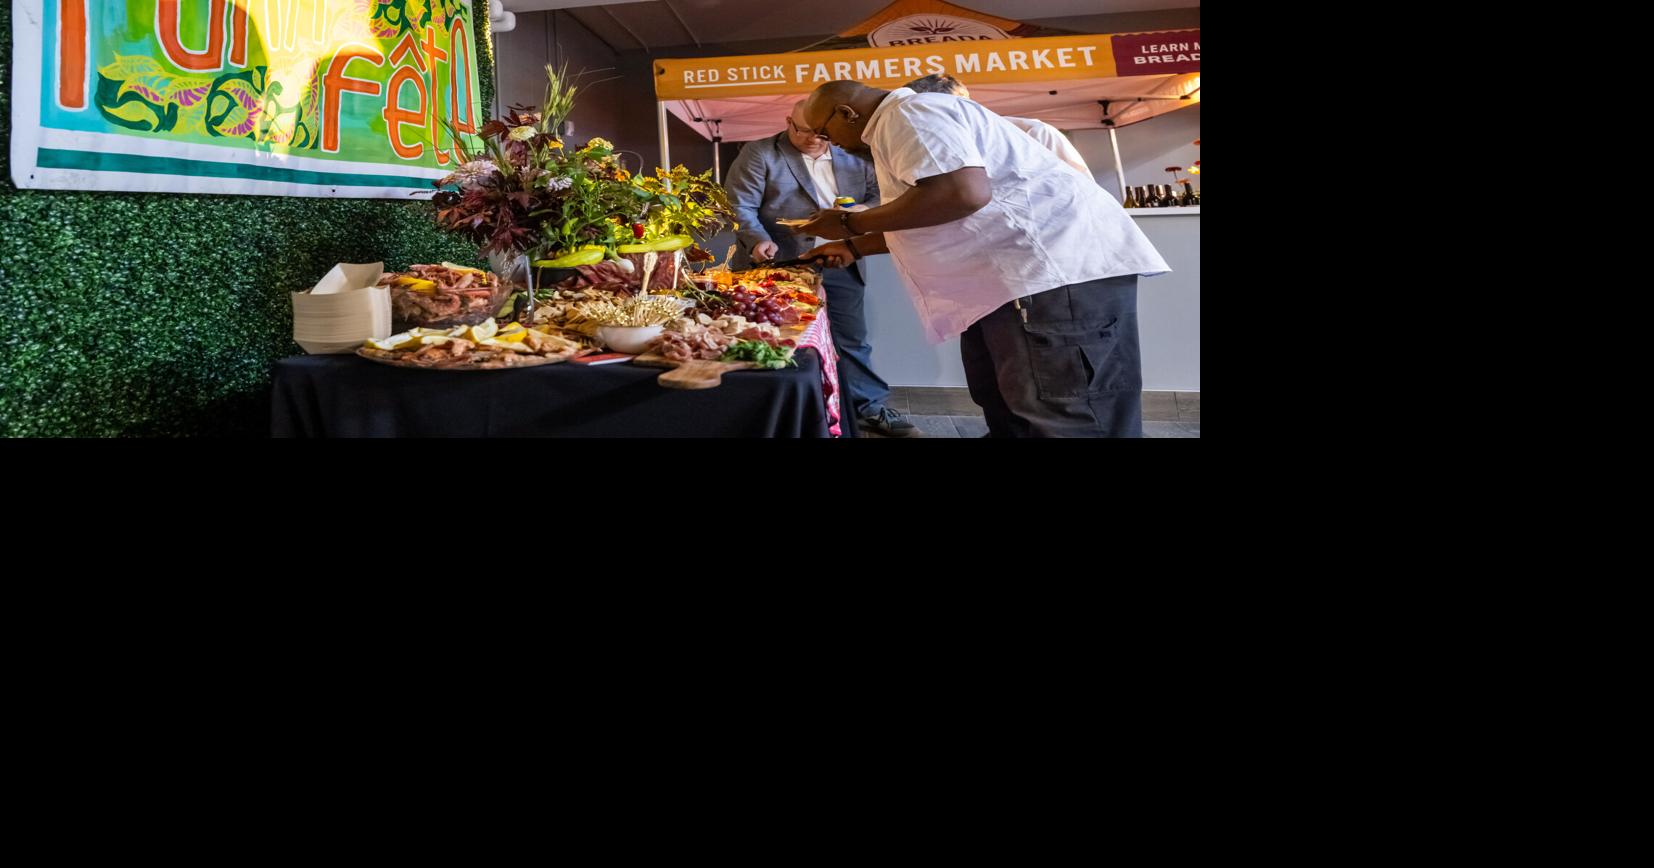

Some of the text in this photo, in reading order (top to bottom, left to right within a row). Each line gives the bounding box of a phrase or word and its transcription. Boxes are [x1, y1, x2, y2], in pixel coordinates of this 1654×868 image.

[1141, 42, 1189, 54] LEARN
[684, 46, 1097, 83] RED STICK FARMERS MARKET
